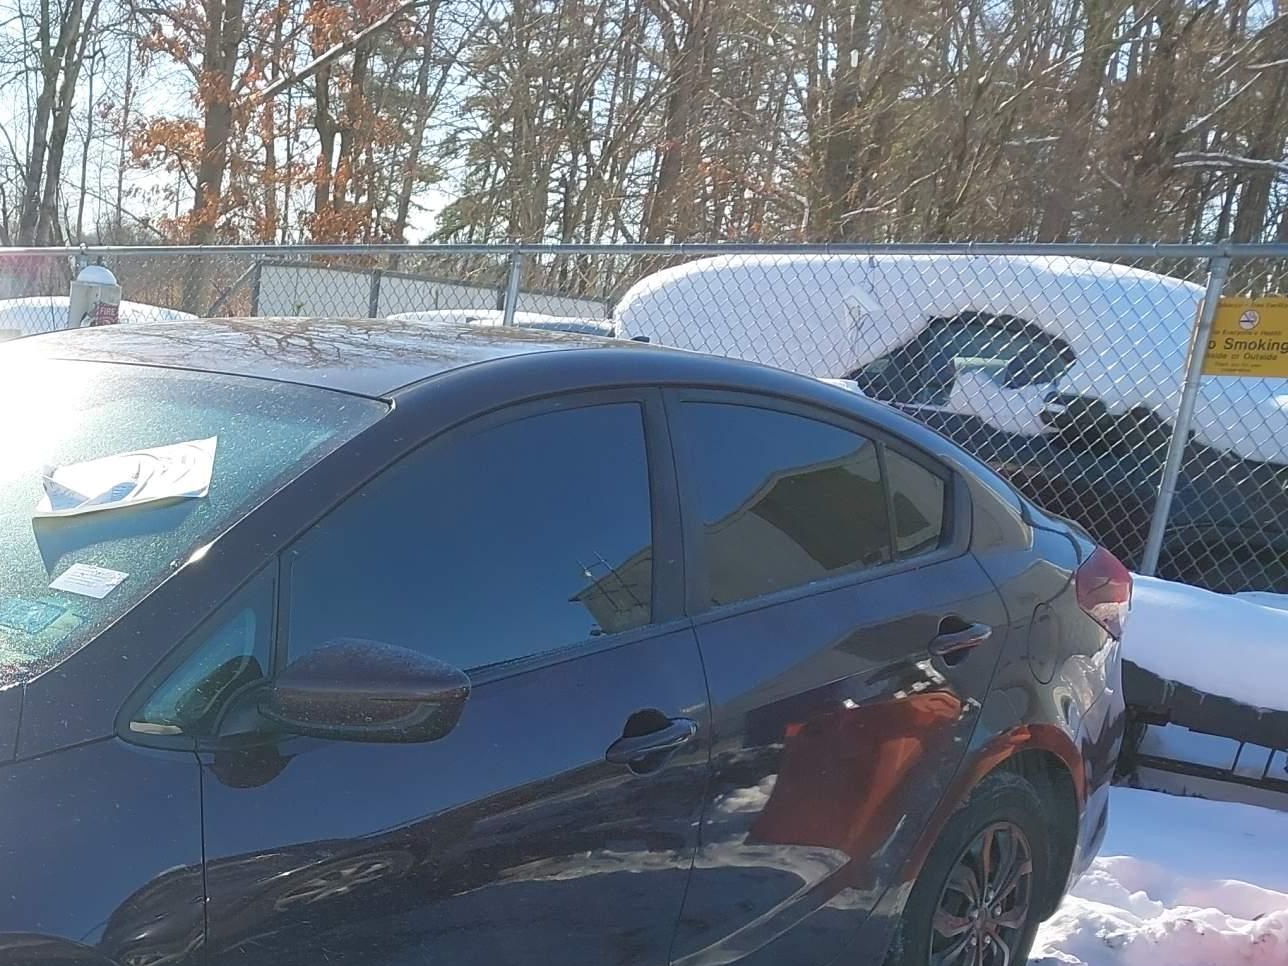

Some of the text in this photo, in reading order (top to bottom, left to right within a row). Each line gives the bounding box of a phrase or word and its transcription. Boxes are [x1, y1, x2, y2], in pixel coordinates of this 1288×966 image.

[99, 306, 117, 317] FIRE
[1208, 337, 1288, 353] o Smoking
[1243, 353, 1278, 361] Outside
